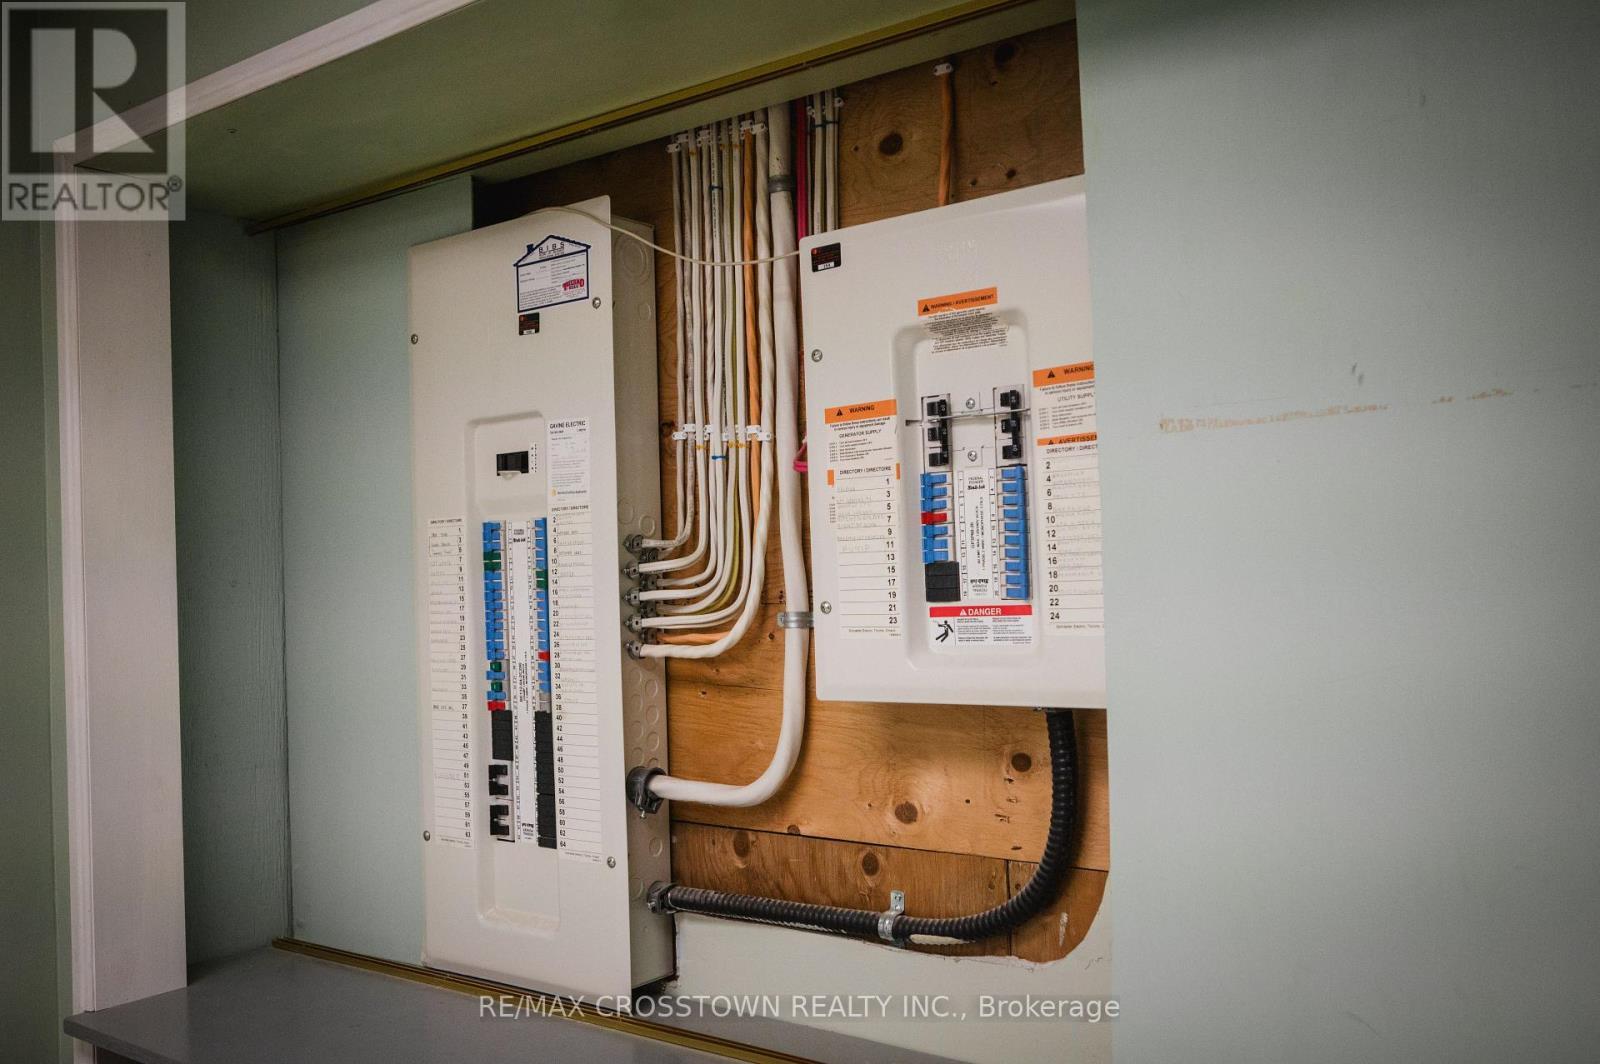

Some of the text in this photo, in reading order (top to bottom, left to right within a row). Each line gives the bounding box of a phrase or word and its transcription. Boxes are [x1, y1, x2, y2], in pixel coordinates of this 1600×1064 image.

[1058, 434, 1097, 444] AVERTISSE
[1046, 446, 1075, 454] DIRECTORY
[1046, 461, 1050, 470] 2
[1047, 488, 1052, 497] 6
[886, 502, 891, 510] 5
[1047, 502, 1053, 510] 8
[1046, 515, 1056, 524] 10
[887, 527, 892, 536] 9
[1047, 529, 1056, 538] 12
[1048, 556, 1057, 565] 16
[1049, 570, 1058, 579] 18
[1049, 584, 1058, 593] 20
[1050, 598, 1059, 606] 22
[968, 608, 1002, 616] DANGER
